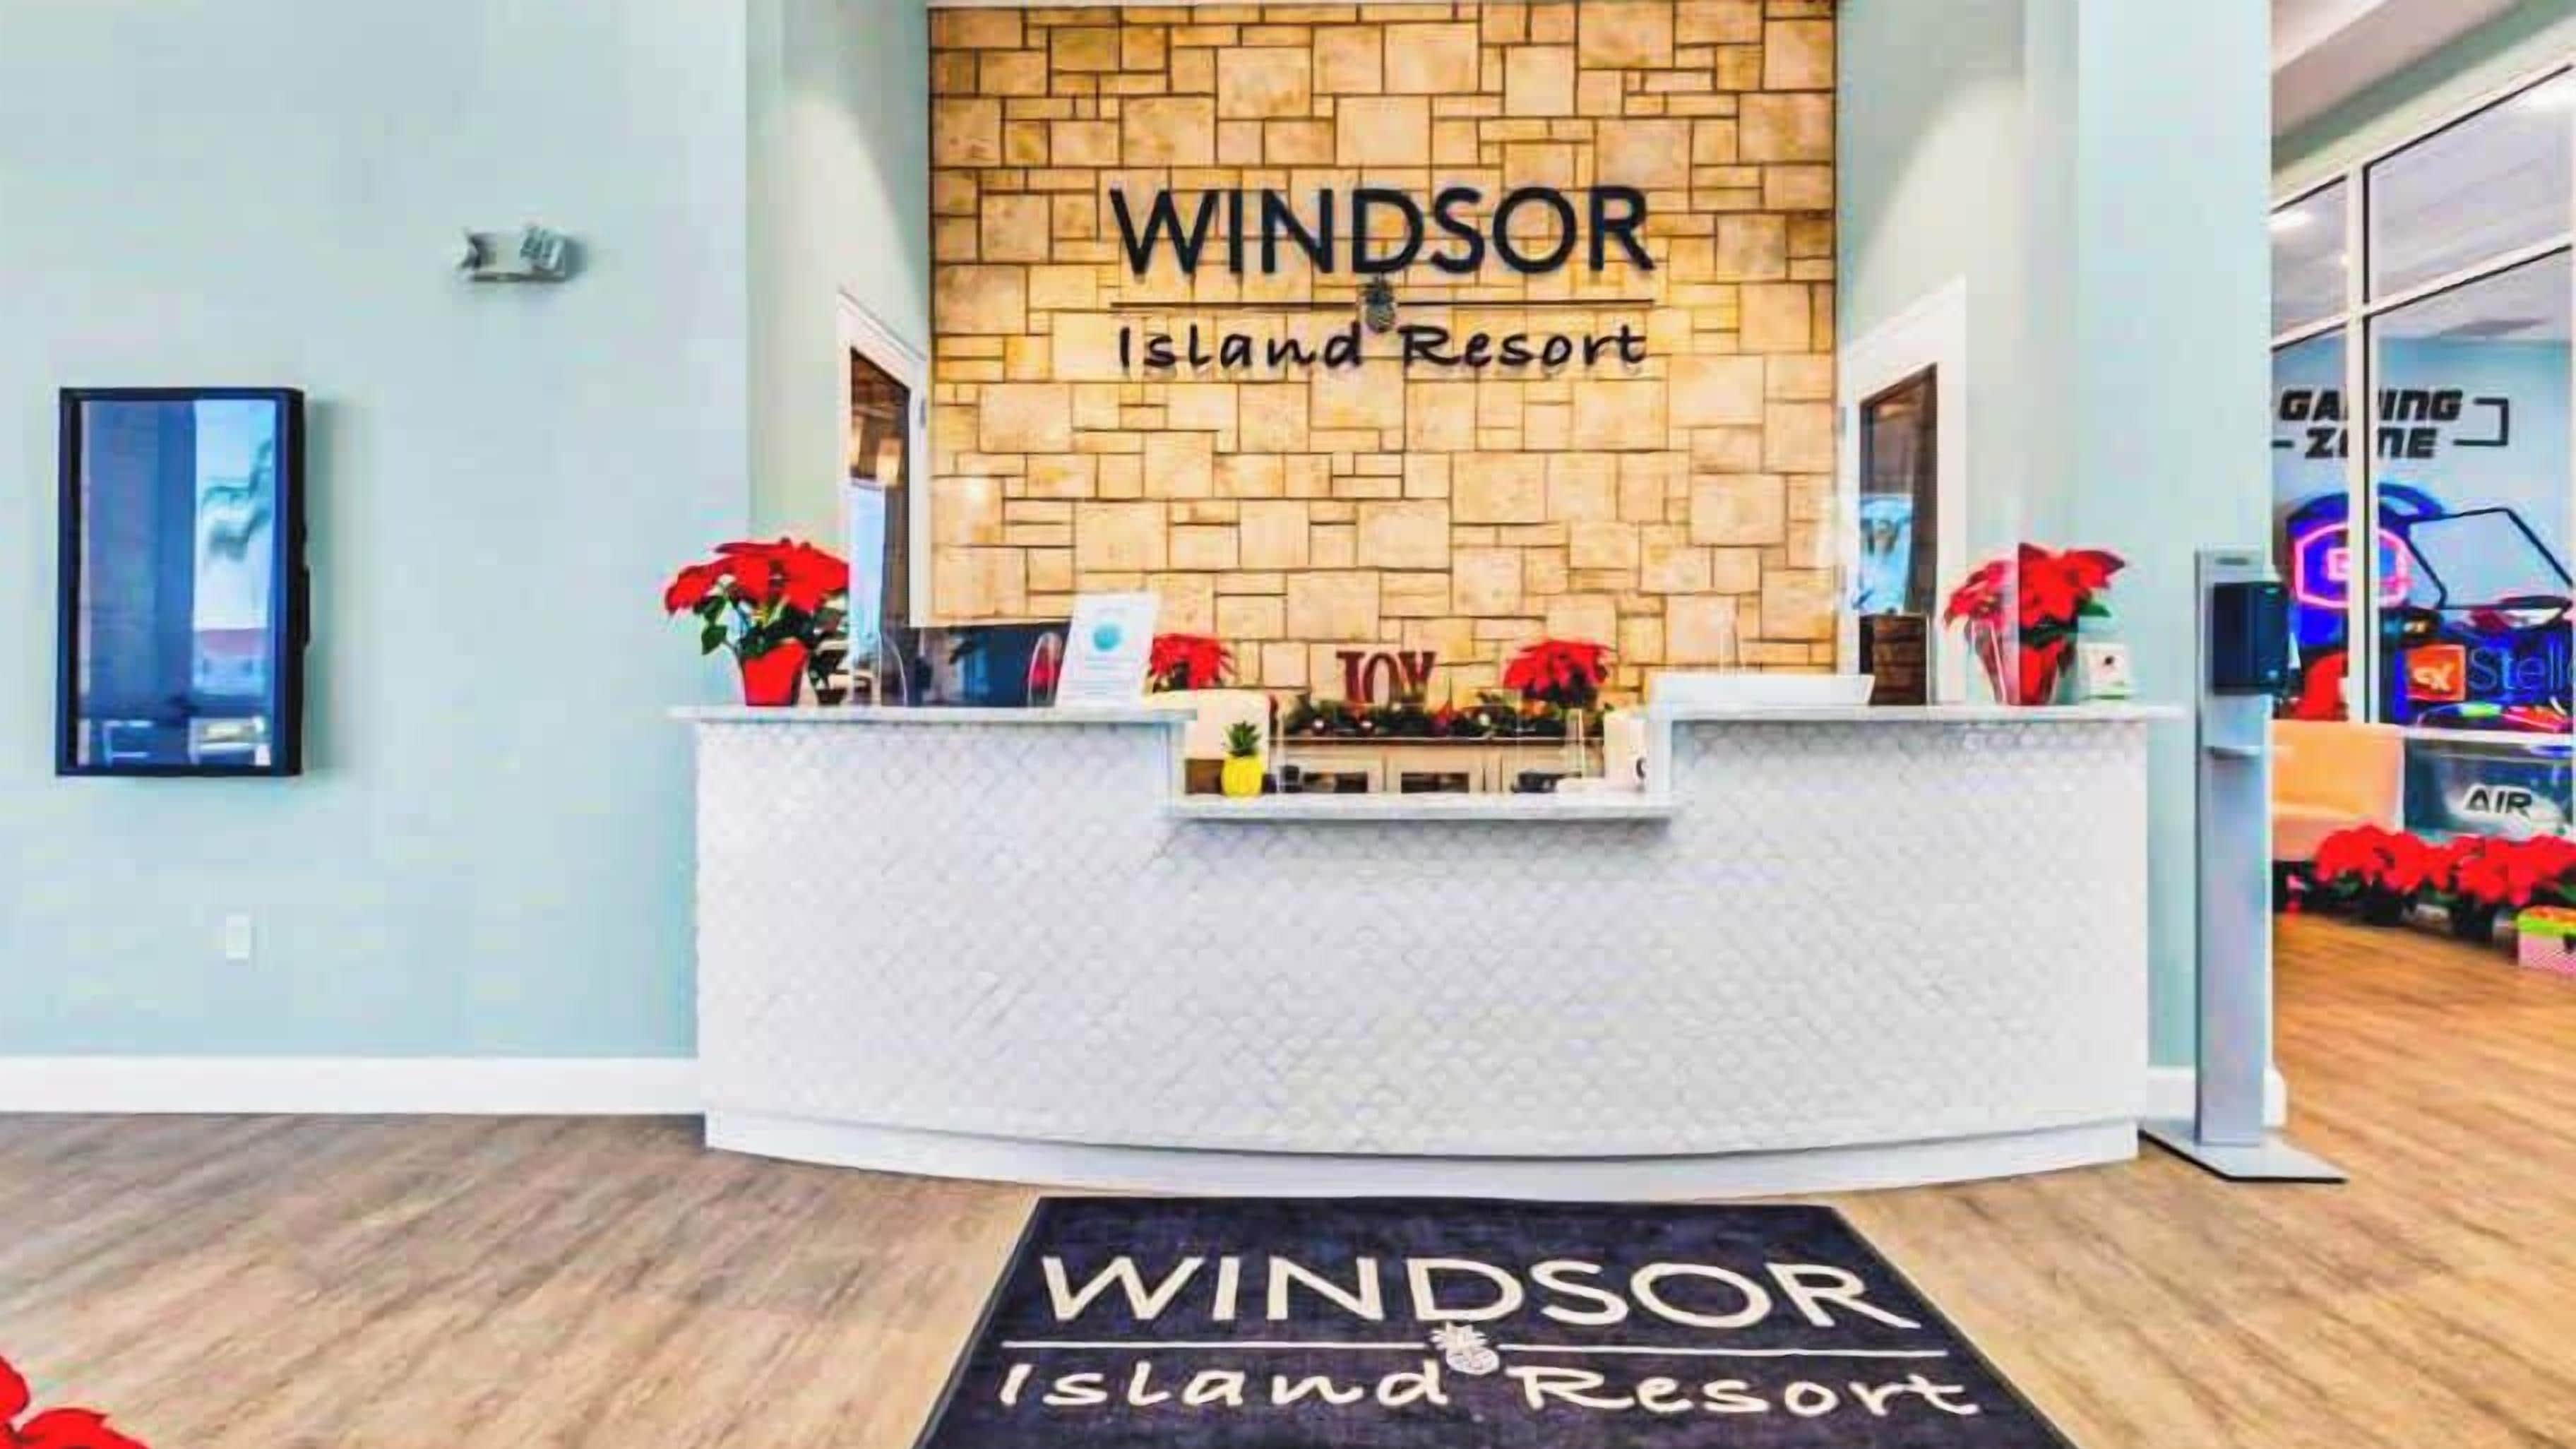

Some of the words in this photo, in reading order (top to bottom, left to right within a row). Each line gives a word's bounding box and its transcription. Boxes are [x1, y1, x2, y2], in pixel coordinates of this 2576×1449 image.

[1109, 186, 1654, 275] WINDSOR
[1118, 324, 1363, 369] Island
[1398, 324, 1648, 369] Resort
[2279, 389, 2463, 422] GAING
[2305, 427, 2438, 459] ZNE
[1335, 650, 1436, 707] JOY
[2464, 787, 2532, 820] AIR
[1042, 1256, 1921, 1330] WINDSOR
[999, 1360, 1449, 1407] Island
[1505, 1366, 1979, 1416] Resort
